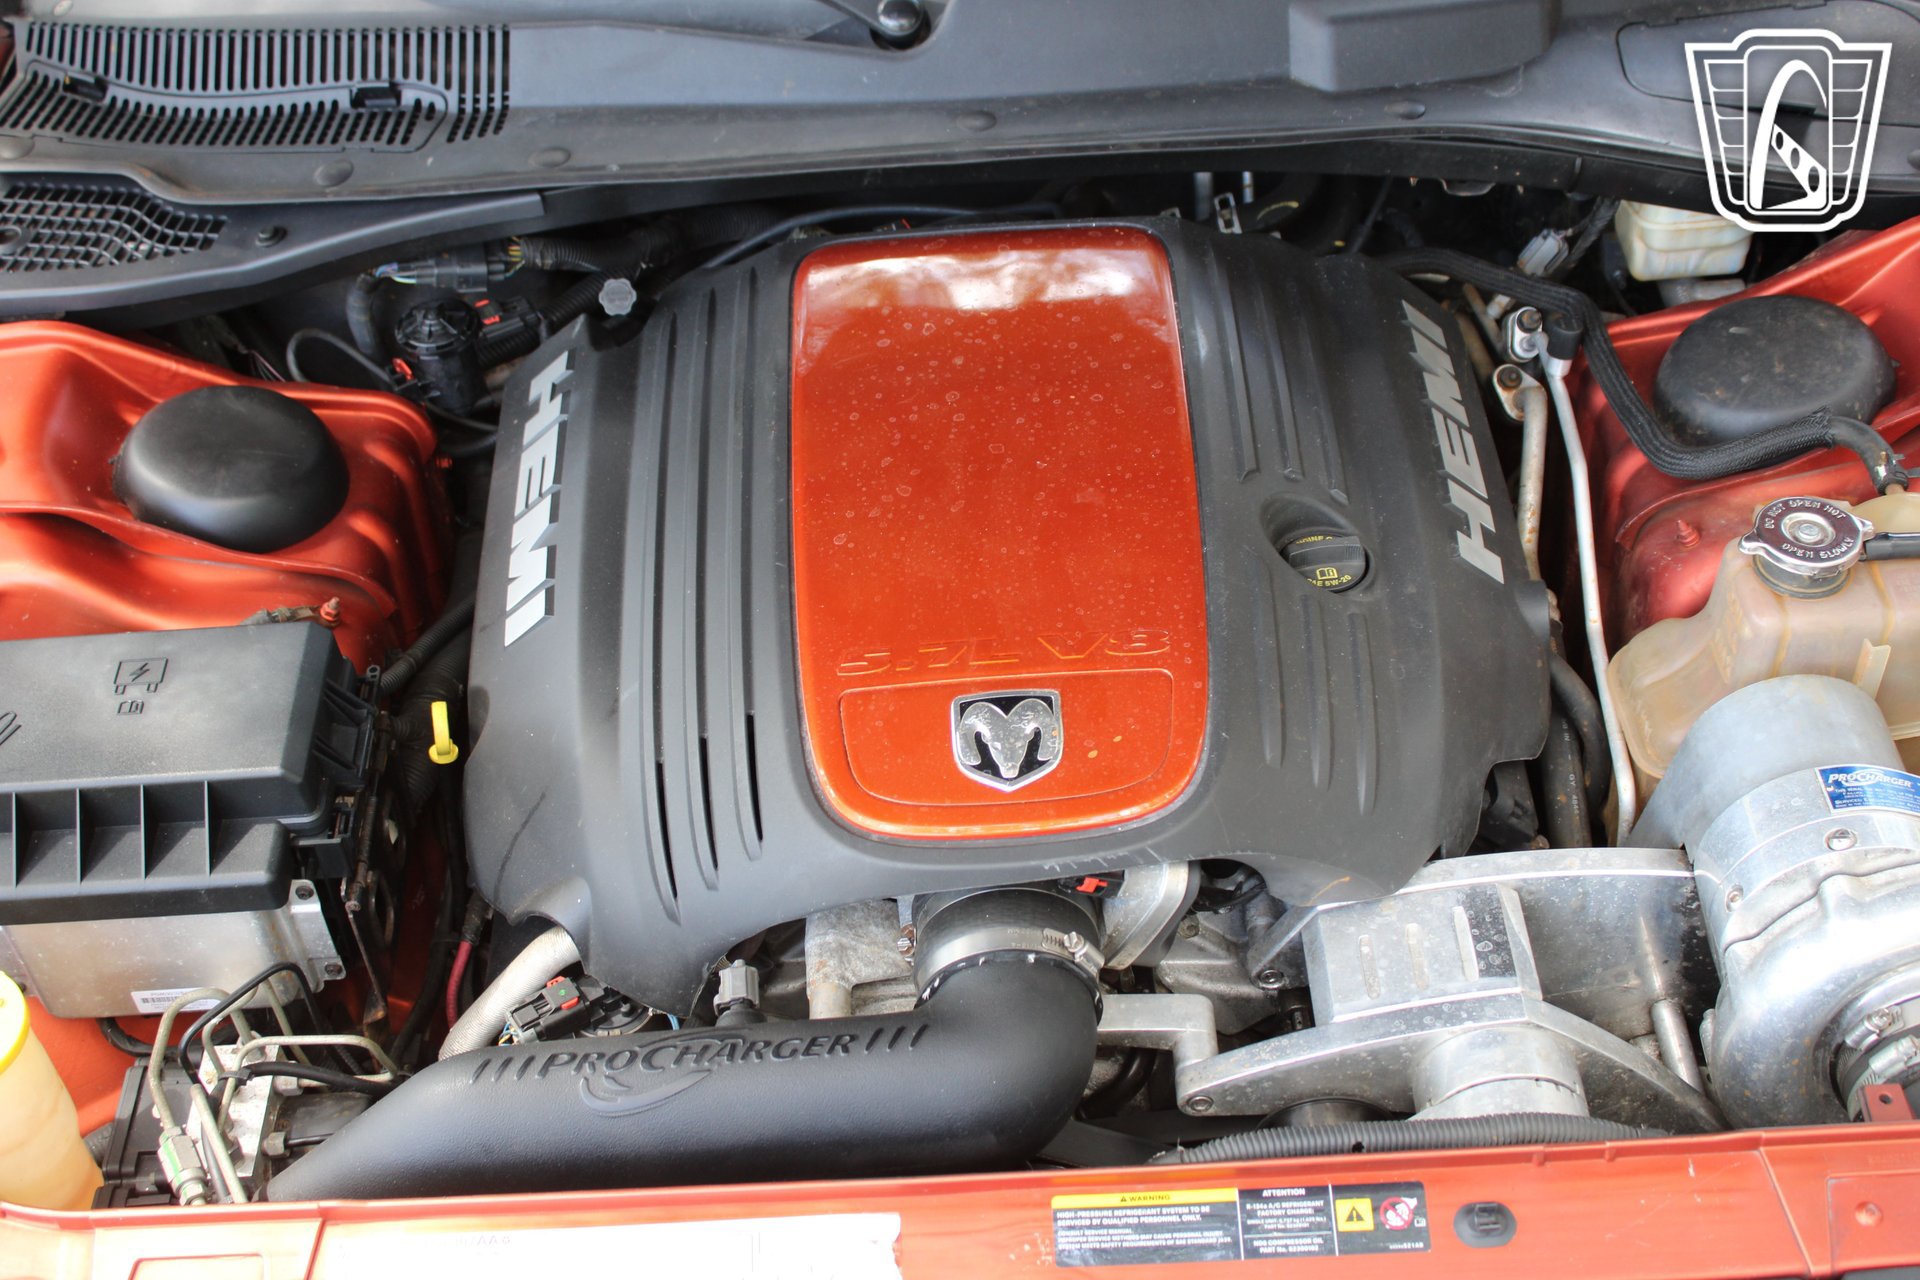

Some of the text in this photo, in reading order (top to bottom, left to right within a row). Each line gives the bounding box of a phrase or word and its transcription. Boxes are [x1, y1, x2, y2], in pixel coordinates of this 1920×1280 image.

[1402, 300, 1504, 584] HEMI
[504, 351, 570, 647] HEMI
[1764, 499, 1847, 529] DO NOT OPEN HOT
[1781, 537, 1855, 559] OPEN SLOWLY
[1324, 574, 1352, 587] 5W-20
[836, 628, 1171, 676] 5.7L V8
[536, 1033, 857, 1079] PROCHARGER
[1129, 1193, 1171, 1202] WARNING
[1262, 1188, 1305, 1197] ATTENTION
[1281, 1200, 1324, 1208] REFRIGERANT
[1056, 1210, 1112, 1219] HIGH-PRESSURE
[1113, 1207, 1161, 1217] REFRIGERANT
[1162, 1206, 1189, 1214] SYSTEM
[1201, 1205, 1210, 1213] BE
[1257, 1209, 1286, 1217] FACTORY
[1057, 1214, 1202, 1227] SERVICED BY QUALIFIED PERSONNEL ONLY.
[1267, 1238, 1312, 1246] COMPRESSOR
[1260, 1246, 1275, 1254] PART
